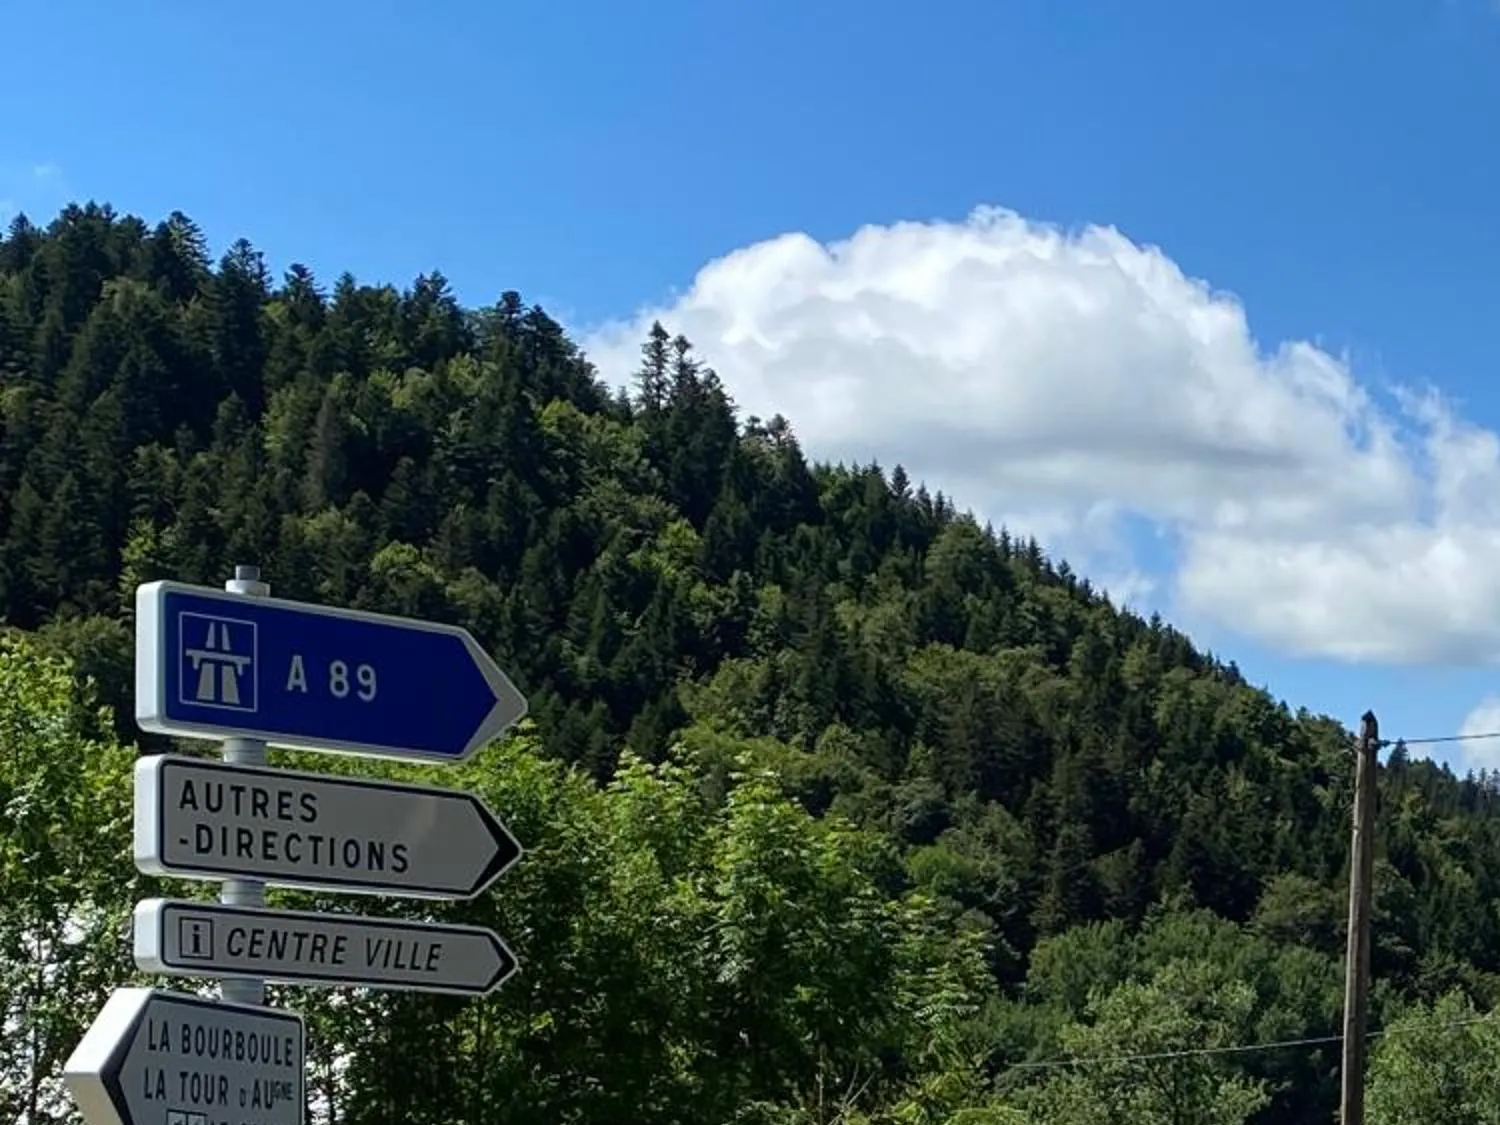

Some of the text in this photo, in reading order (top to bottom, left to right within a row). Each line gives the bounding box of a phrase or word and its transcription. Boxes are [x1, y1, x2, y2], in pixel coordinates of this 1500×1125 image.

[287, 655, 377, 701] A 89
[179, 779, 318, 823] AUTRES
[227, 927, 347, 964] CENTRE
[366, 937, 442, 972] VILLE
[148, 1018, 293, 1067] LA BOURBOULE
[144, 1067, 166, 1100] LA
[180, 1071, 229, 1106] TOUR
